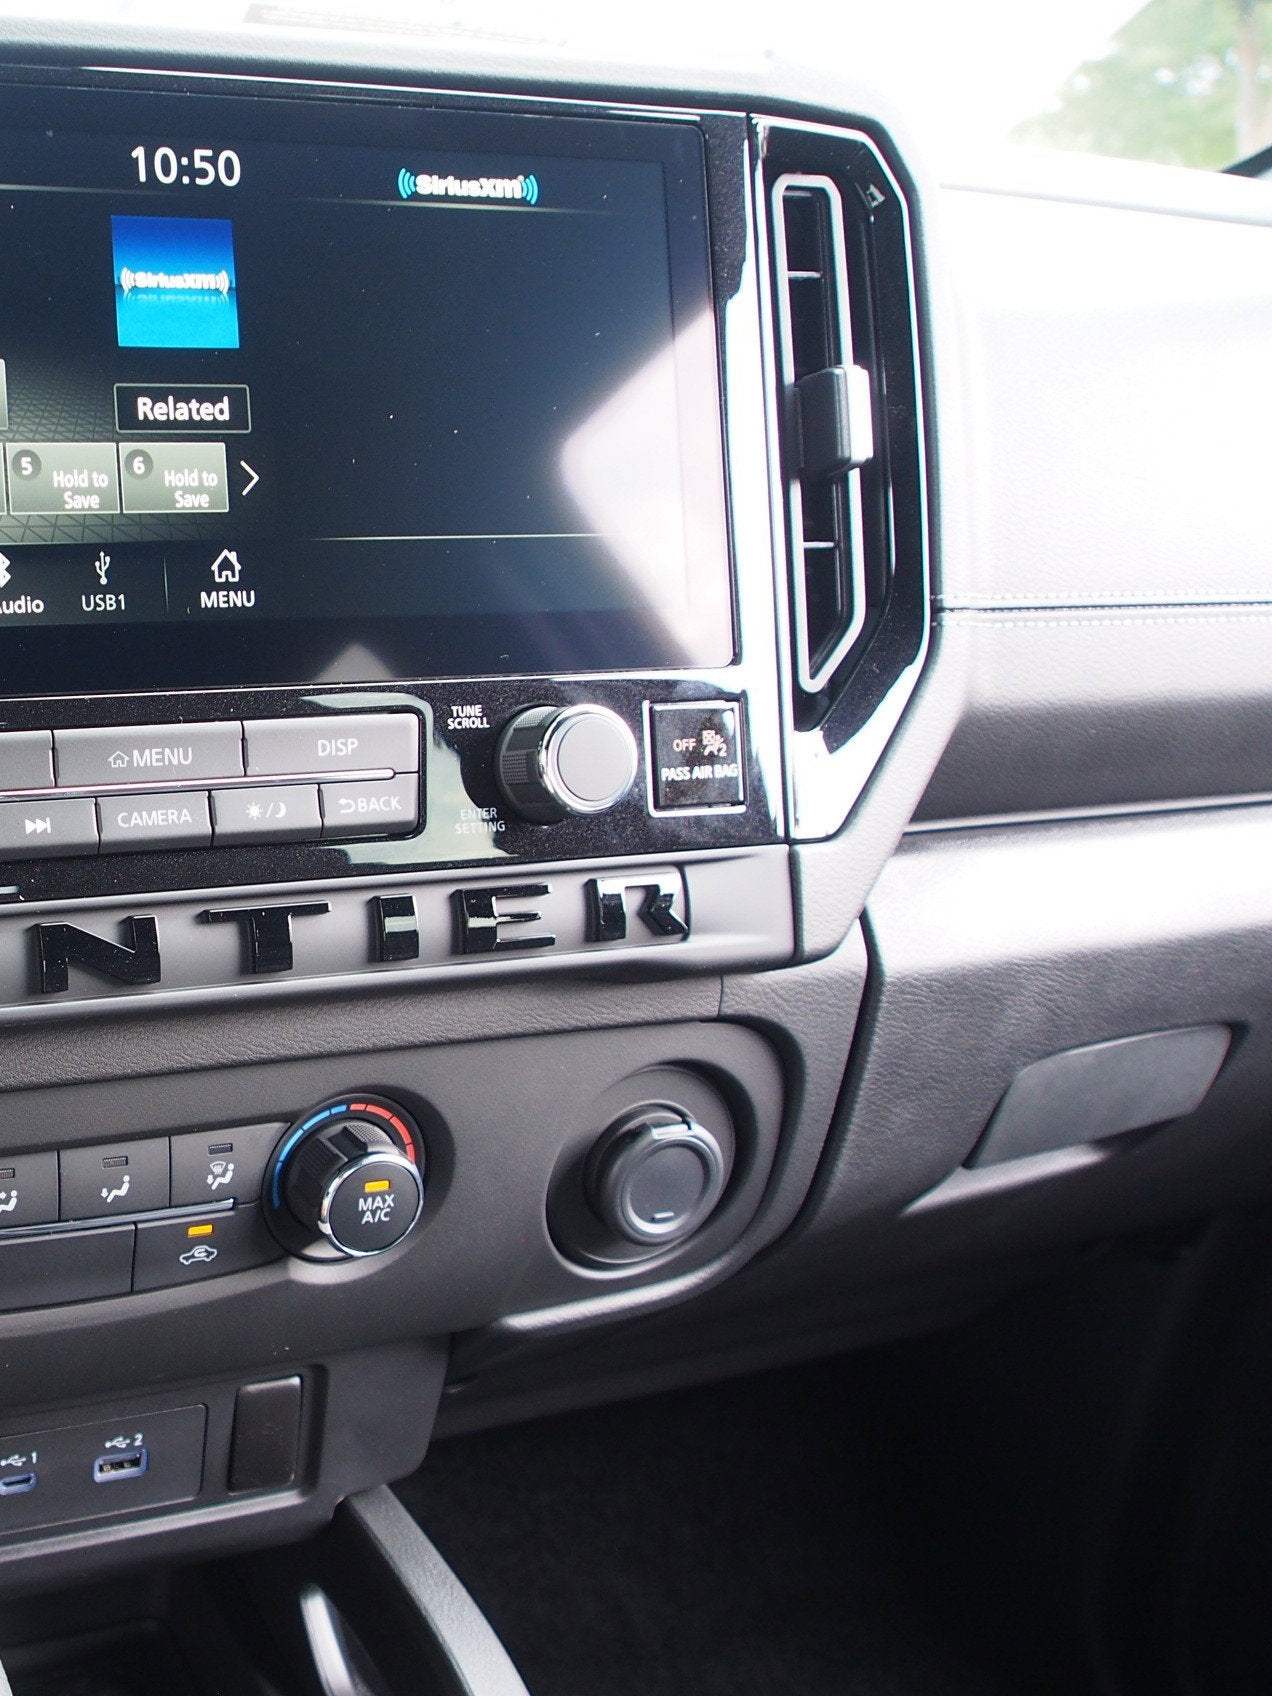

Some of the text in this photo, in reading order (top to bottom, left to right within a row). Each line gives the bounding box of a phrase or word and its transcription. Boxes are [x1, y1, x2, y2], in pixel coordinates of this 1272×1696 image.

[130, 146, 242, 187] 10:50
[136, 395, 230, 422] Related
[20, 457, 34, 476] 5
[132, 457, 146, 475] 6
[53, 468, 109, 488] Hold to
[164, 468, 218, 488] Hold to
[63, 492, 100, 509] Save
[174, 491, 209, 508] Save
[81, 594, 126, 612] USB1
[200, 590, 256, 609] MENU
[450, 705, 483, 717] TUNE
[447, 717, 490, 730] SCROLL
[317, 737, 359, 758] DISP
[672, 738, 696, 753] OFF
[131, 746, 193, 769] MENU
[661, 763, 738, 782] PASS AIR BAG
[356, 796, 402, 814] BACK
[460, 807, 498, 821] ENTER
[117, 809, 192, 829] CAMERA
[454, 820, 506, 835] SETTING
[358, 1193, 395, 1212] MAX
[361, 1208, 391, 1225] A/C
[134, 1433, 144, 1447] 2
[31, 1451, 37, 1464] 1
